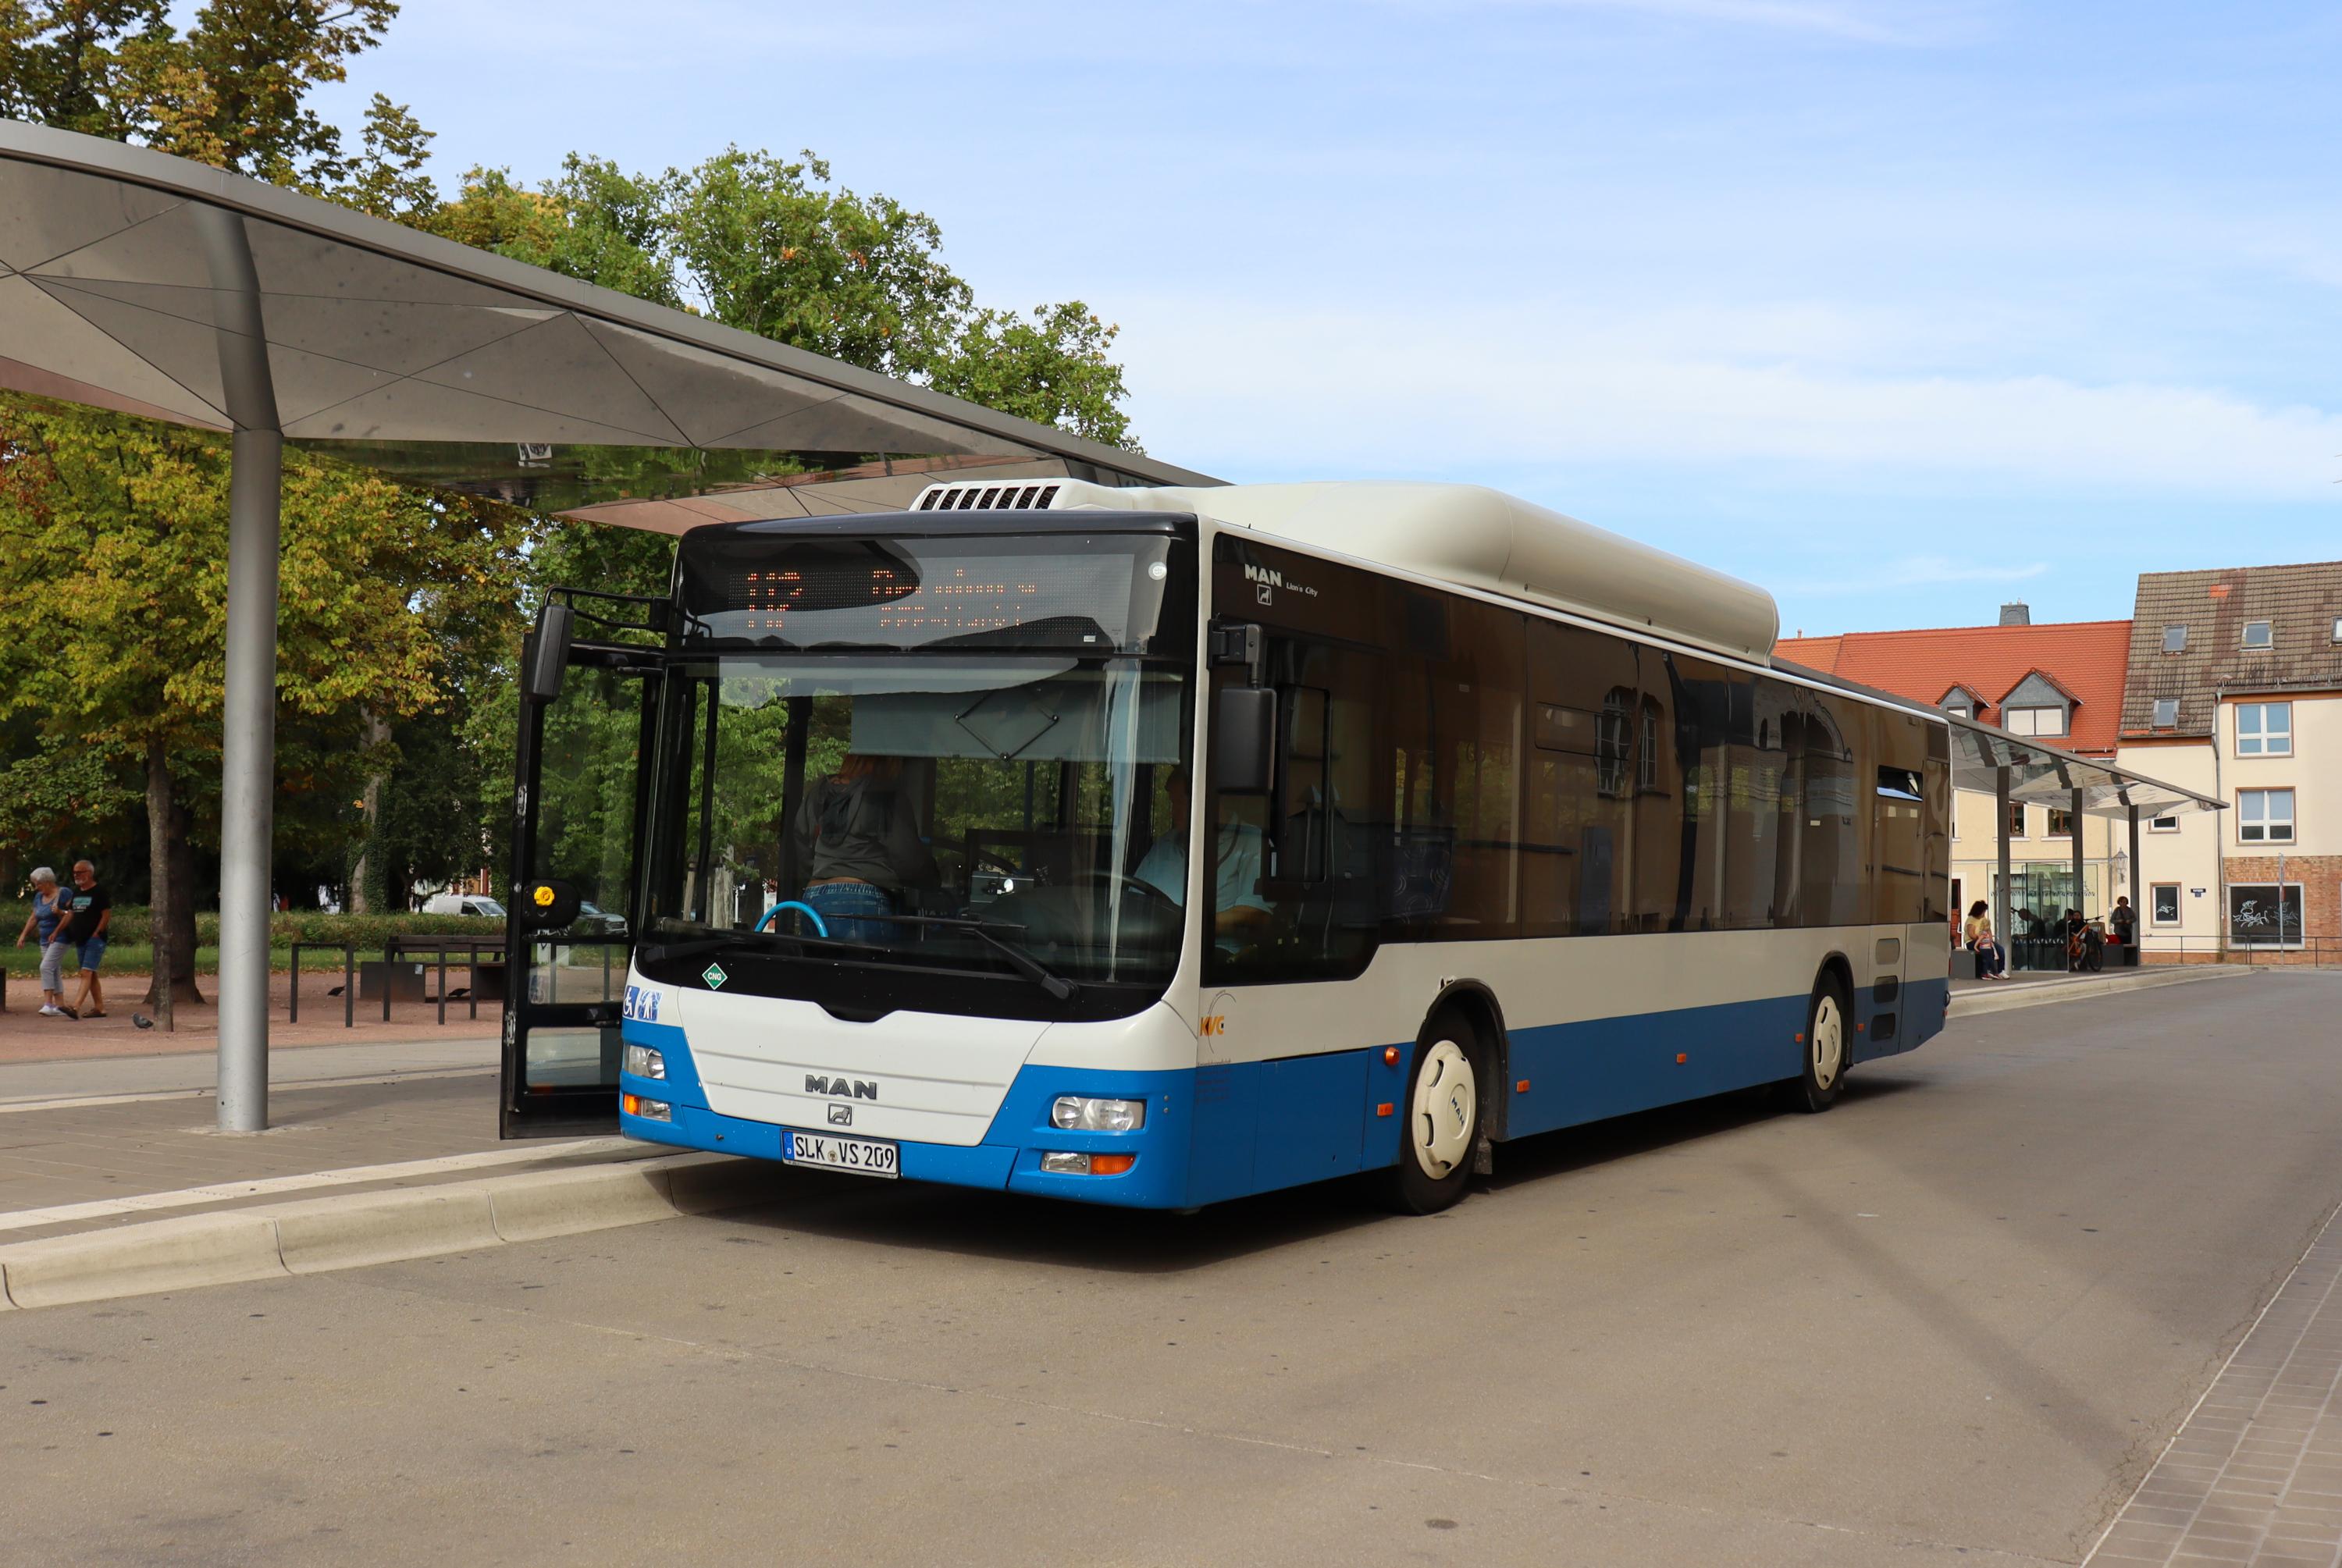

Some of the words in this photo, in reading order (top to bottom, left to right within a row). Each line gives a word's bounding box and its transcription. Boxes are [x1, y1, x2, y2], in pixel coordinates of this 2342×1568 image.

[1244, 563, 1282, 588] MAN
[1305, 586, 1319, 598] City
[707, 972, 722, 981] CNG
[805, 1074, 877, 1100] MAN
[1451, 1096, 1465, 1128] MAN
[795, 1136, 825, 1161] SLK
[838, 1141, 859, 1164] VS
[863, 1145, 895, 1169] 209
